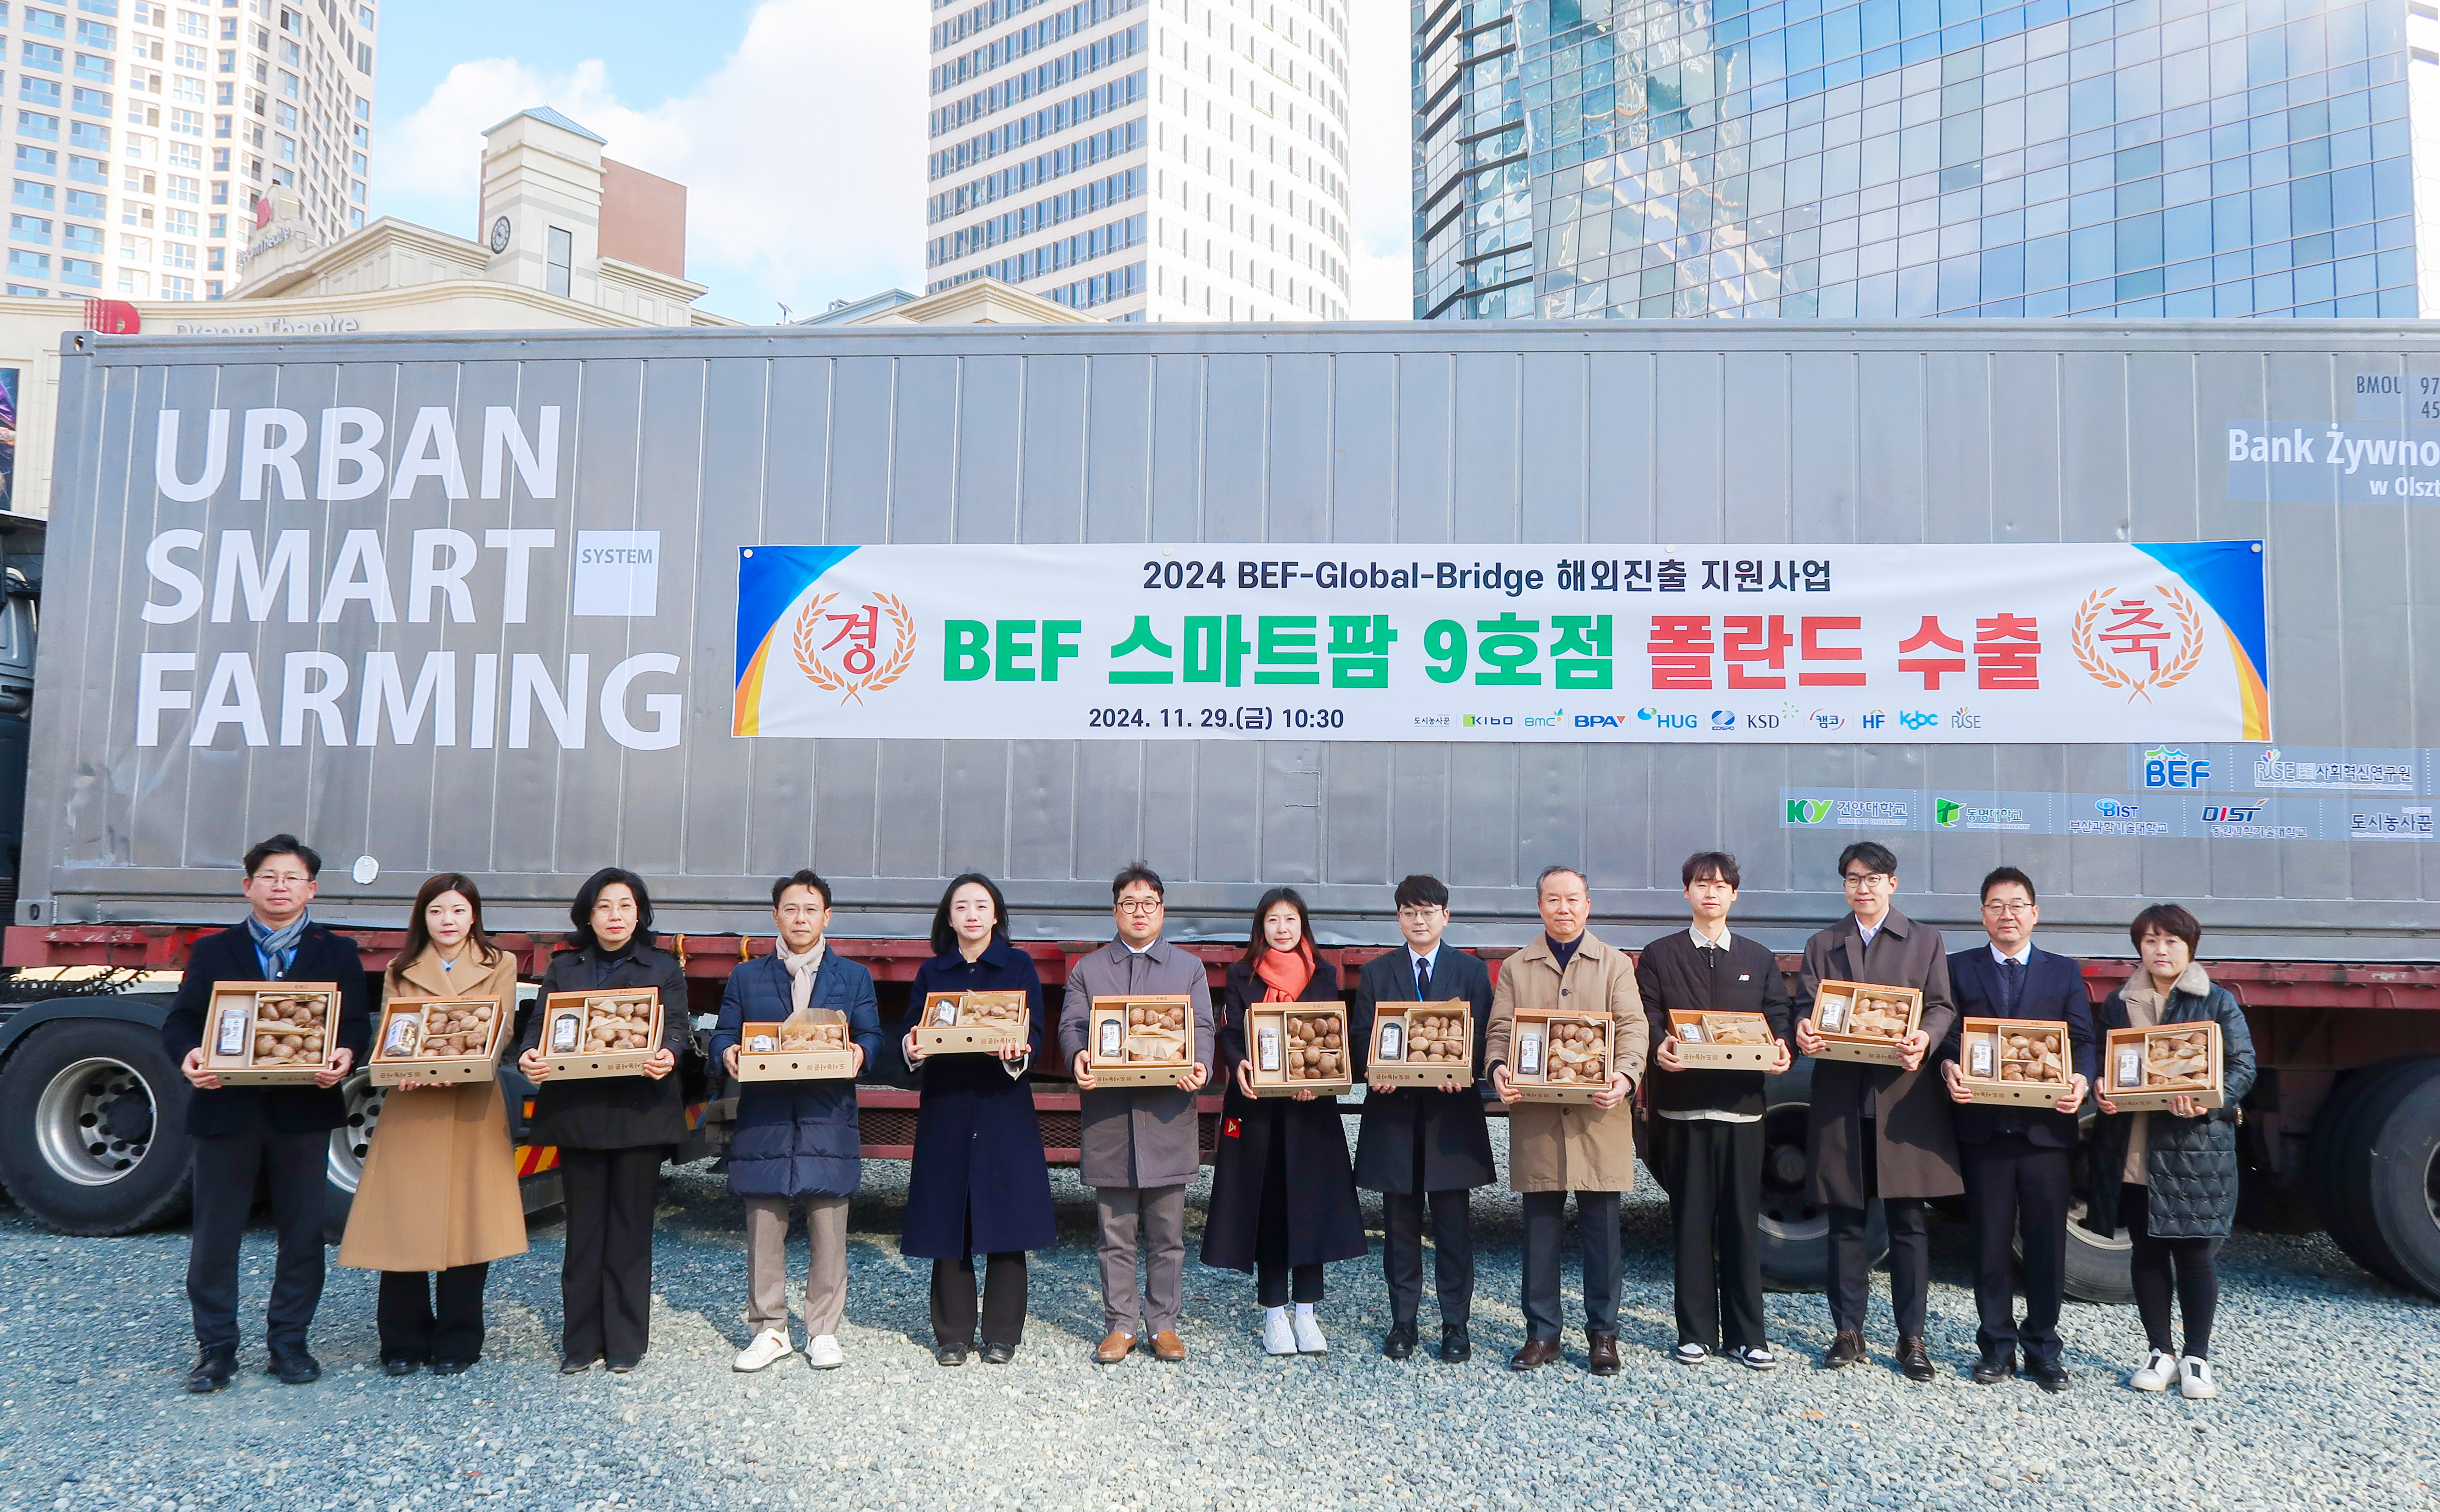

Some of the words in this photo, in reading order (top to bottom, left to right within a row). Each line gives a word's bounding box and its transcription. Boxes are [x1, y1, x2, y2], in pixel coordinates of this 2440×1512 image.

[155, 405, 560, 503] URBAN
[2229, 428, 2315, 463] Bank
[2326, 422, 2440, 474] Żywno
[2369, 480, 2388, 495] w
[581, 548, 653, 565] SYSTEM
[140, 527, 555, 625] SMART
[1143, 561, 1226, 589] 2024
[1238, 561, 1544, 597] BEF-Global-Bridge
[1557, 559, 1687, 593] 해외진출
[1701, 559, 1832, 593] 지원사업
[821, 604, 878, 675] 경
[2098, 599, 2171, 671] 축
[943, 619, 1082, 681] BEF
[1108, 614, 1398, 688] 스마트팜
[1423, 612, 1614, 690] 9호점
[1646, 614, 1867, 690] 폴란드
[1898, 612, 2041, 690] 수출
[136, 651, 683, 751] FARMING
[1089, 708, 1151, 728] 2024.
[1160, 708, 1192, 728] 11.
[1200, 706, 1273, 731] 29.(금)
[1283, 708, 1344, 729] 10:30
[1414, 716, 1450, 725] 도시농사꾼
[1575, 715, 1619, 727] BPA
[1657, 714, 1697, 728] HUG
[1746, 714, 1779, 728] KSD
[1816, 715, 1839, 729] 캠코
[1863, 715, 1885, 729] HF
[2145, 759, 2211, 788] BEF
[2316, 763, 2412, 782] 사회혁신연구원
[1837, 801, 1908, 817] 건양대학교
[1966, 808, 2023, 822] 동명대학교
[2201, 806, 2263, 823] DIST
[2069, 820, 2168, 835] 부산과학기술대학교
[2351, 813, 2433, 832] 도시농사꾼
[2210, 824, 2308, 839] 동원과학기술대학교
